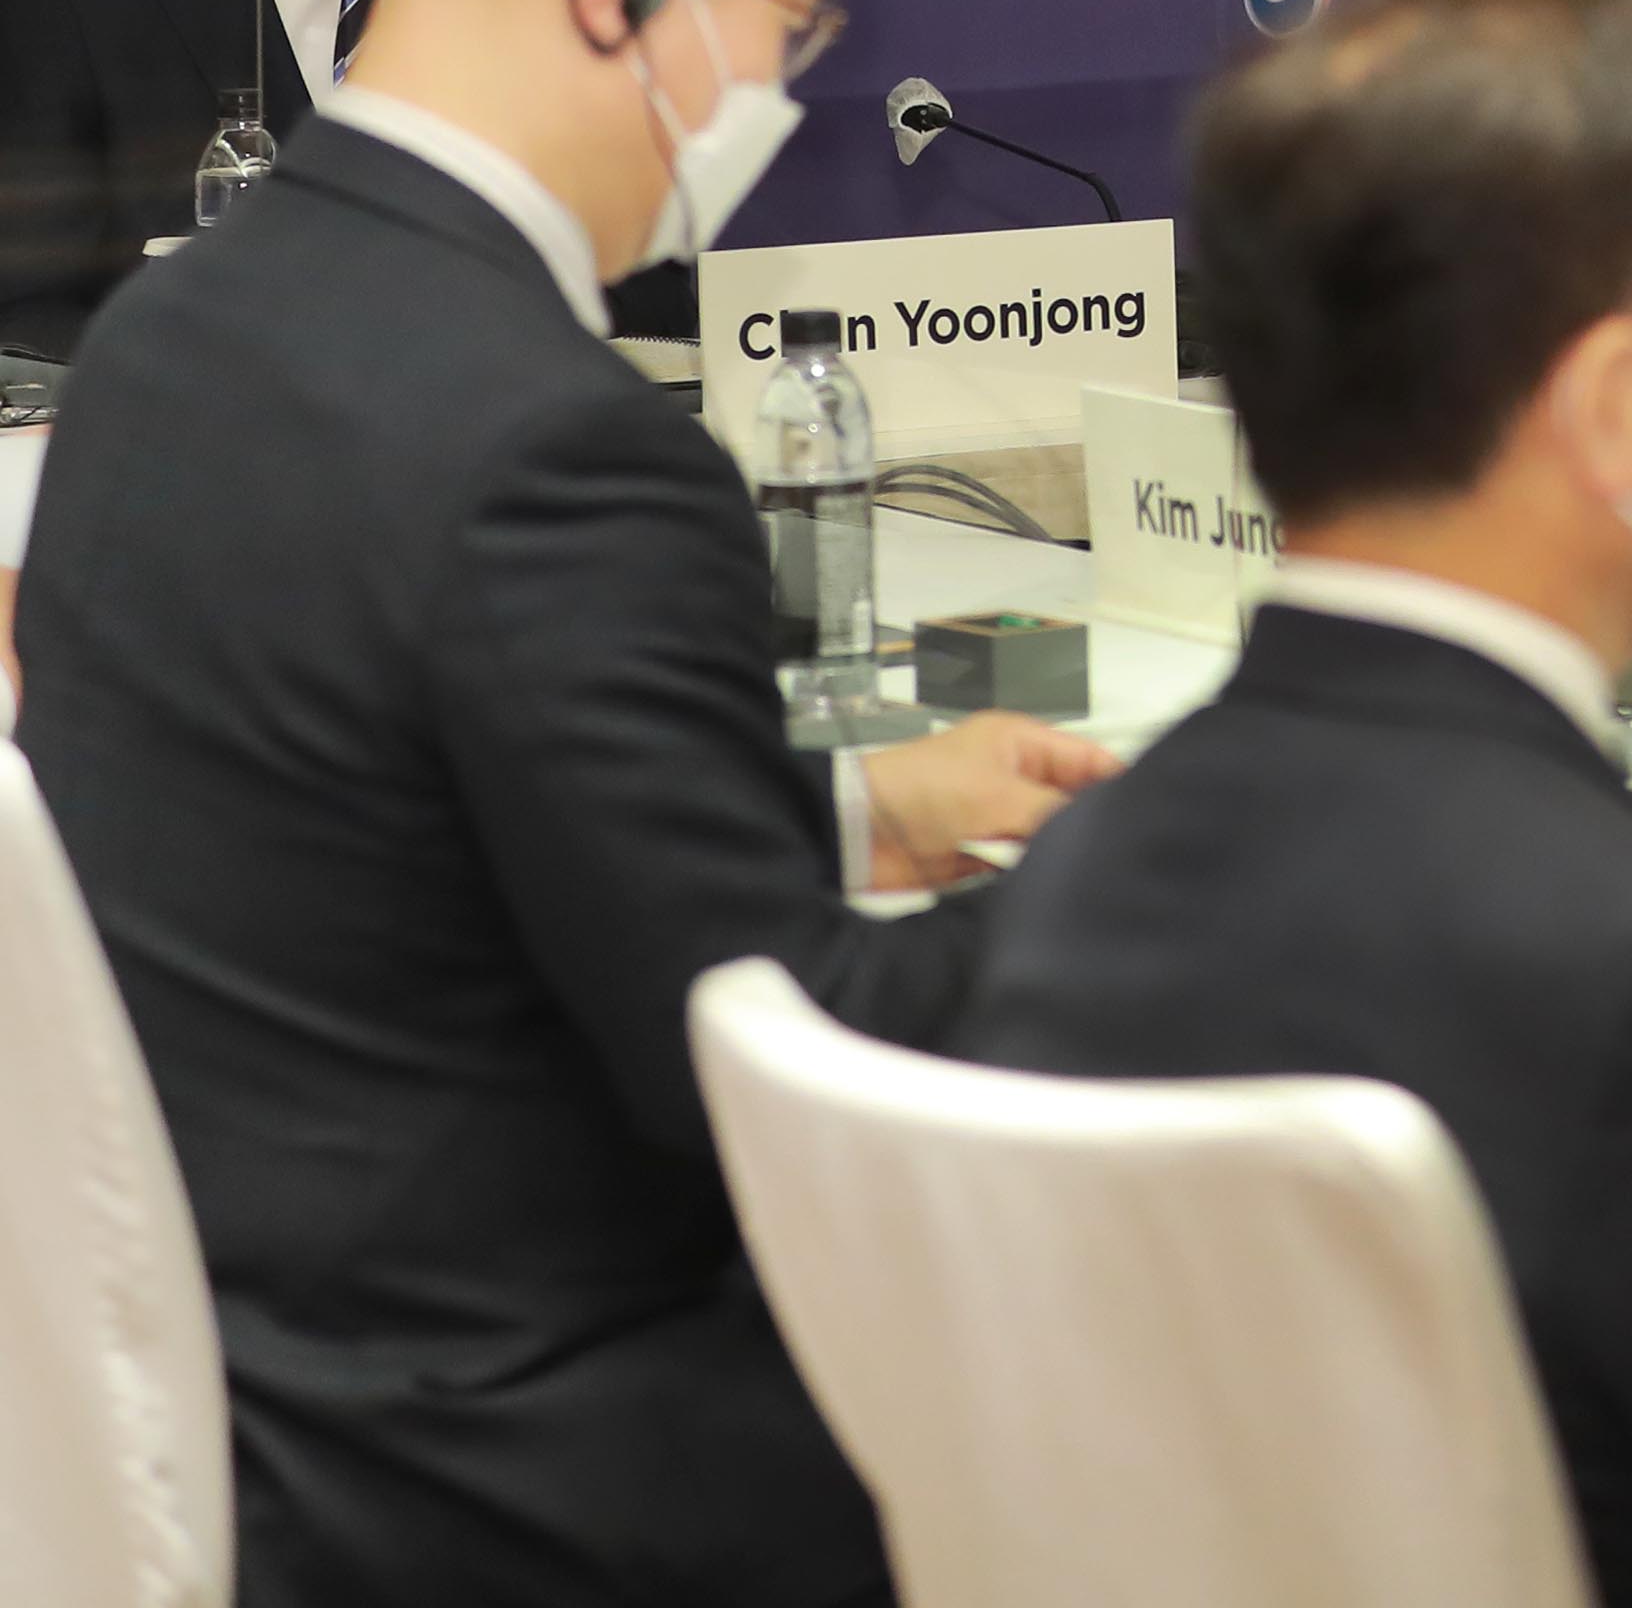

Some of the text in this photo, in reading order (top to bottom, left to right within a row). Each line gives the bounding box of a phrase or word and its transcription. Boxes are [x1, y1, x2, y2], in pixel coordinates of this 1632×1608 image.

[738, 287, 1147, 362] Cn Yoonjong
[1133, 478, 1200, 543] Kim
